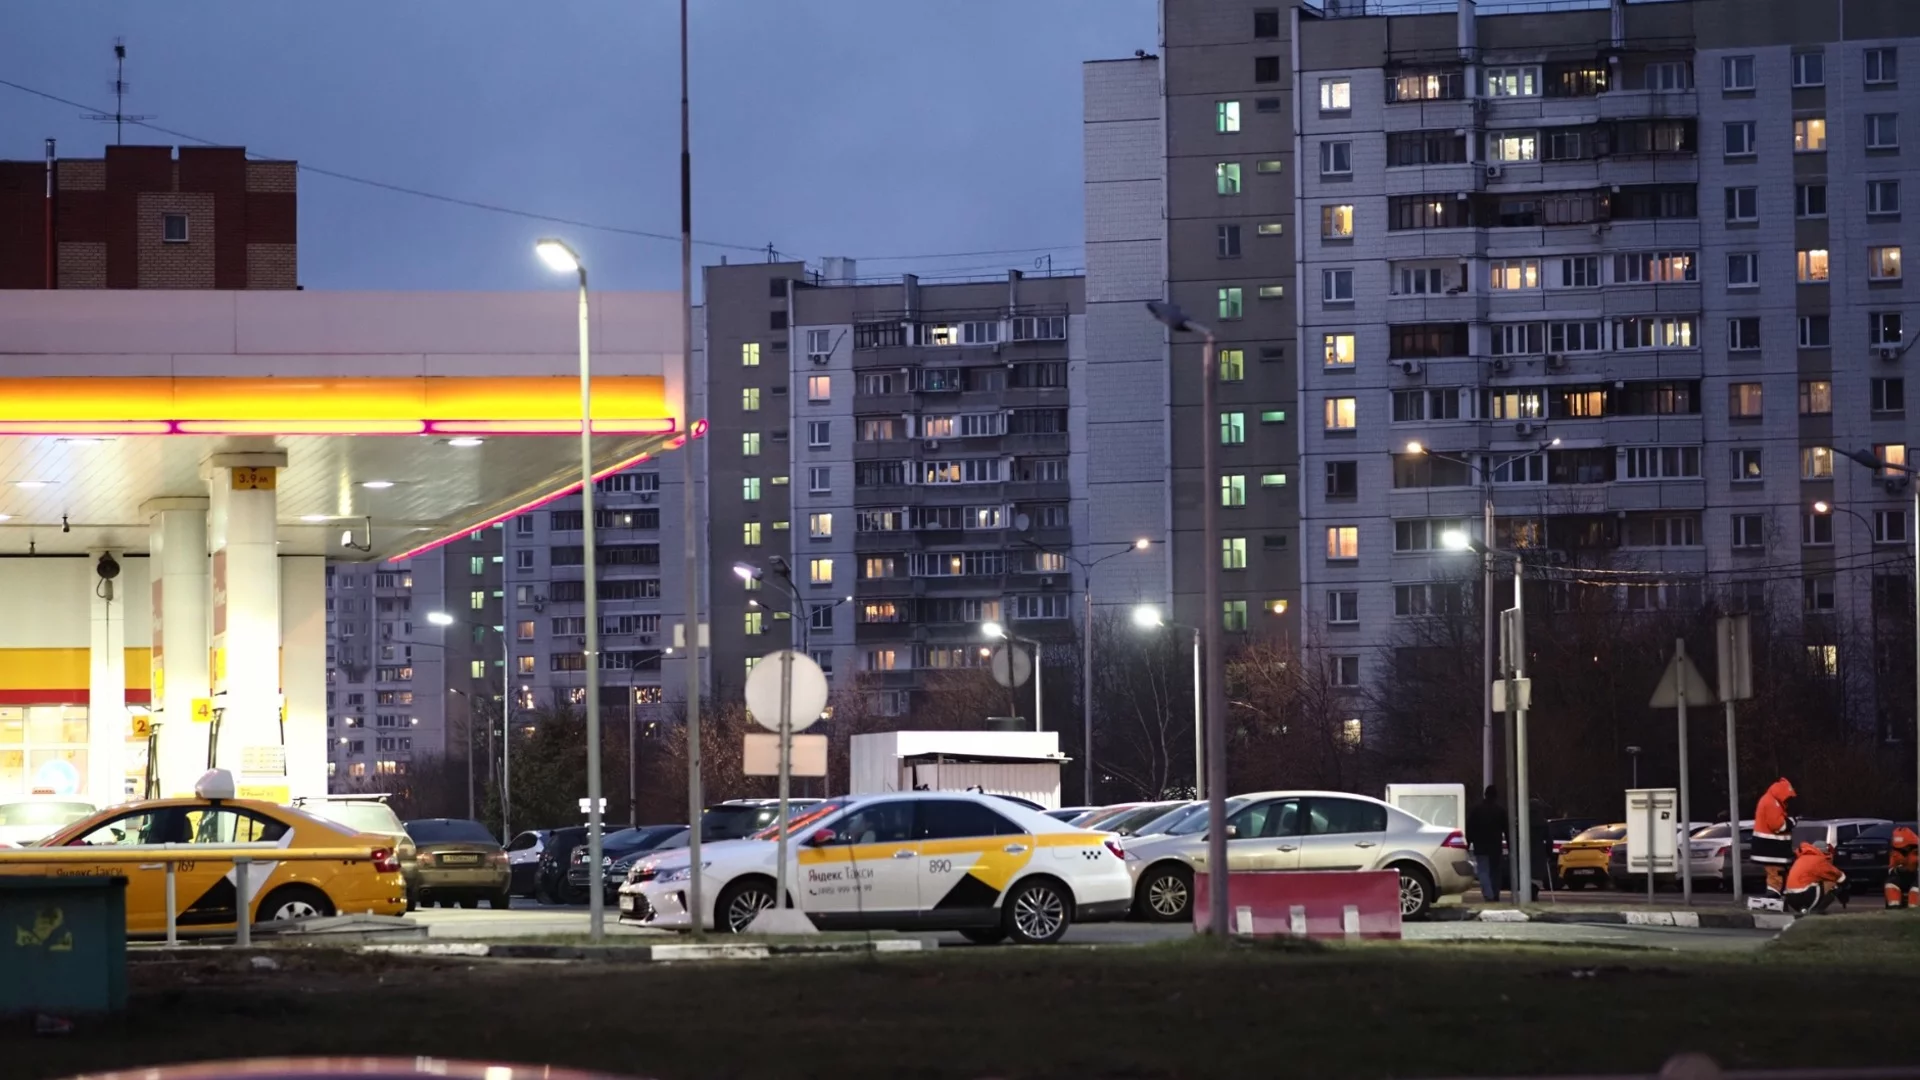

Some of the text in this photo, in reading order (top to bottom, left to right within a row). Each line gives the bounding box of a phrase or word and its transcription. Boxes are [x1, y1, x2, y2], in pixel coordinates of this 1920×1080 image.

[239, 473, 256, 483] 3.9
[198, 704, 209, 717] 4
[136, 720, 146, 732] 2
[929, 859, 951, 873] 890
[808, 865, 874, 882] Яндекс Такси
